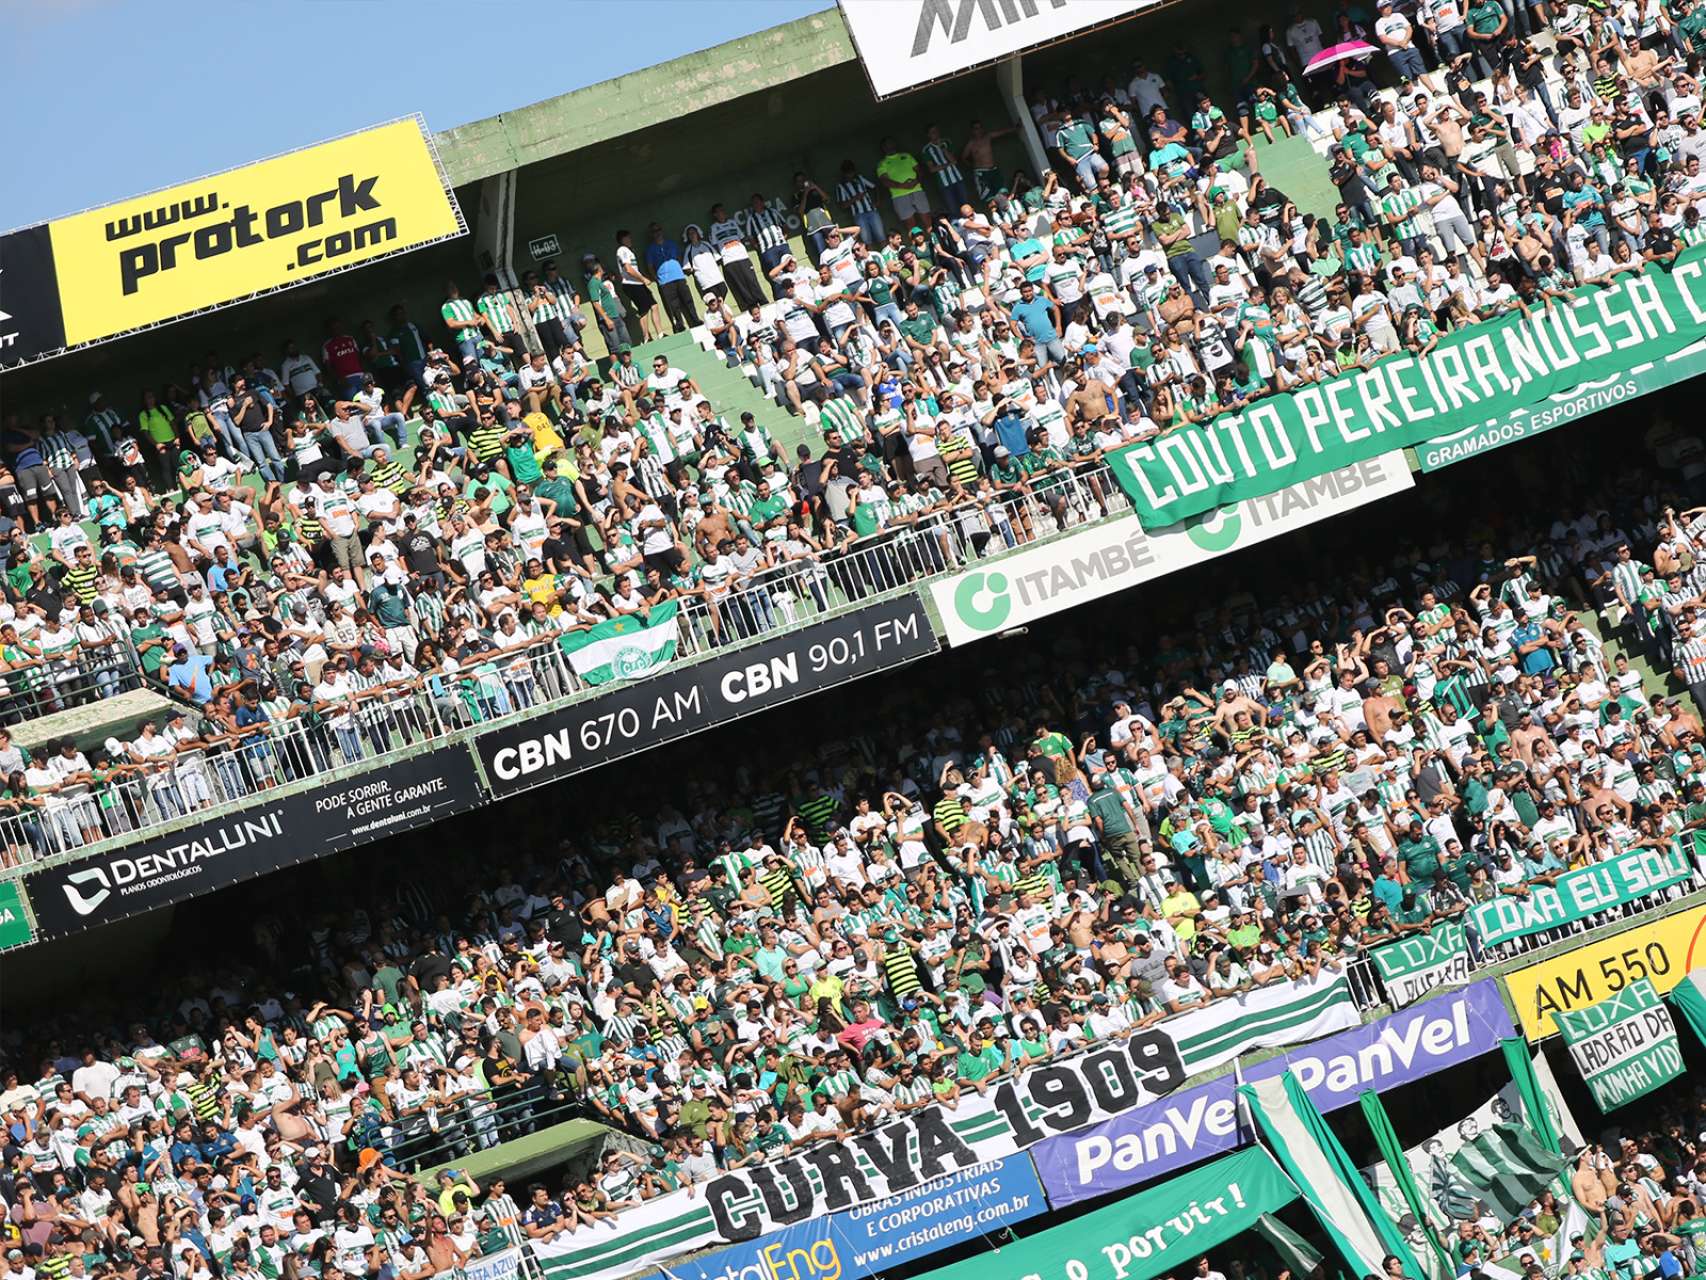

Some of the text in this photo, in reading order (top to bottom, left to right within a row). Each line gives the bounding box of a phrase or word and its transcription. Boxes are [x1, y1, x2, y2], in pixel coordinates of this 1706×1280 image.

[105, 192, 230, 241] www.
[120, 174, 382, 296] protork
[287, 216, 397, 271] .com
[1125, 403, 1297, 510] COUTO
[1426, 421, 1524, 467] GRAMADOS
[1530, 380, 1638, 432] ESPORTIVOS
[1015, 530, 1155, 607] ITAMBÉ
[720, 613, 919, 703] CBN 90,1 FM
[493, 686, 701, 780] CBN 670 AM
[315, 780, 391, 813] PODE SORRIR.
[346, 777, 447, 819] A GENTE GARANTE.
[110, 813, 283, 885] DENTALUNI
[120, 882, 146, 895] PLANOS
[1474, 840, 1689, 944] COXA EU SOU
[1375, 924, 1463, 976] COXA
[1536, 942, 1671, 1021] AM 550
[1560, 979, 1660, 1039] COXA
[1644, 1007, 1674, 1038] DA
[1289, 1000, 1472, 1093] PanVel
[1592, 1061, 1652, 1110] MINHA
[705, 1028, 1187, 1242] CURVA 1909
[1075, 1095, 1236, 1185] PanVe
[849, 1194, 902, 1221] OBRAS
[866, 1178, 1001, 1237] E CORPORATIVAS
